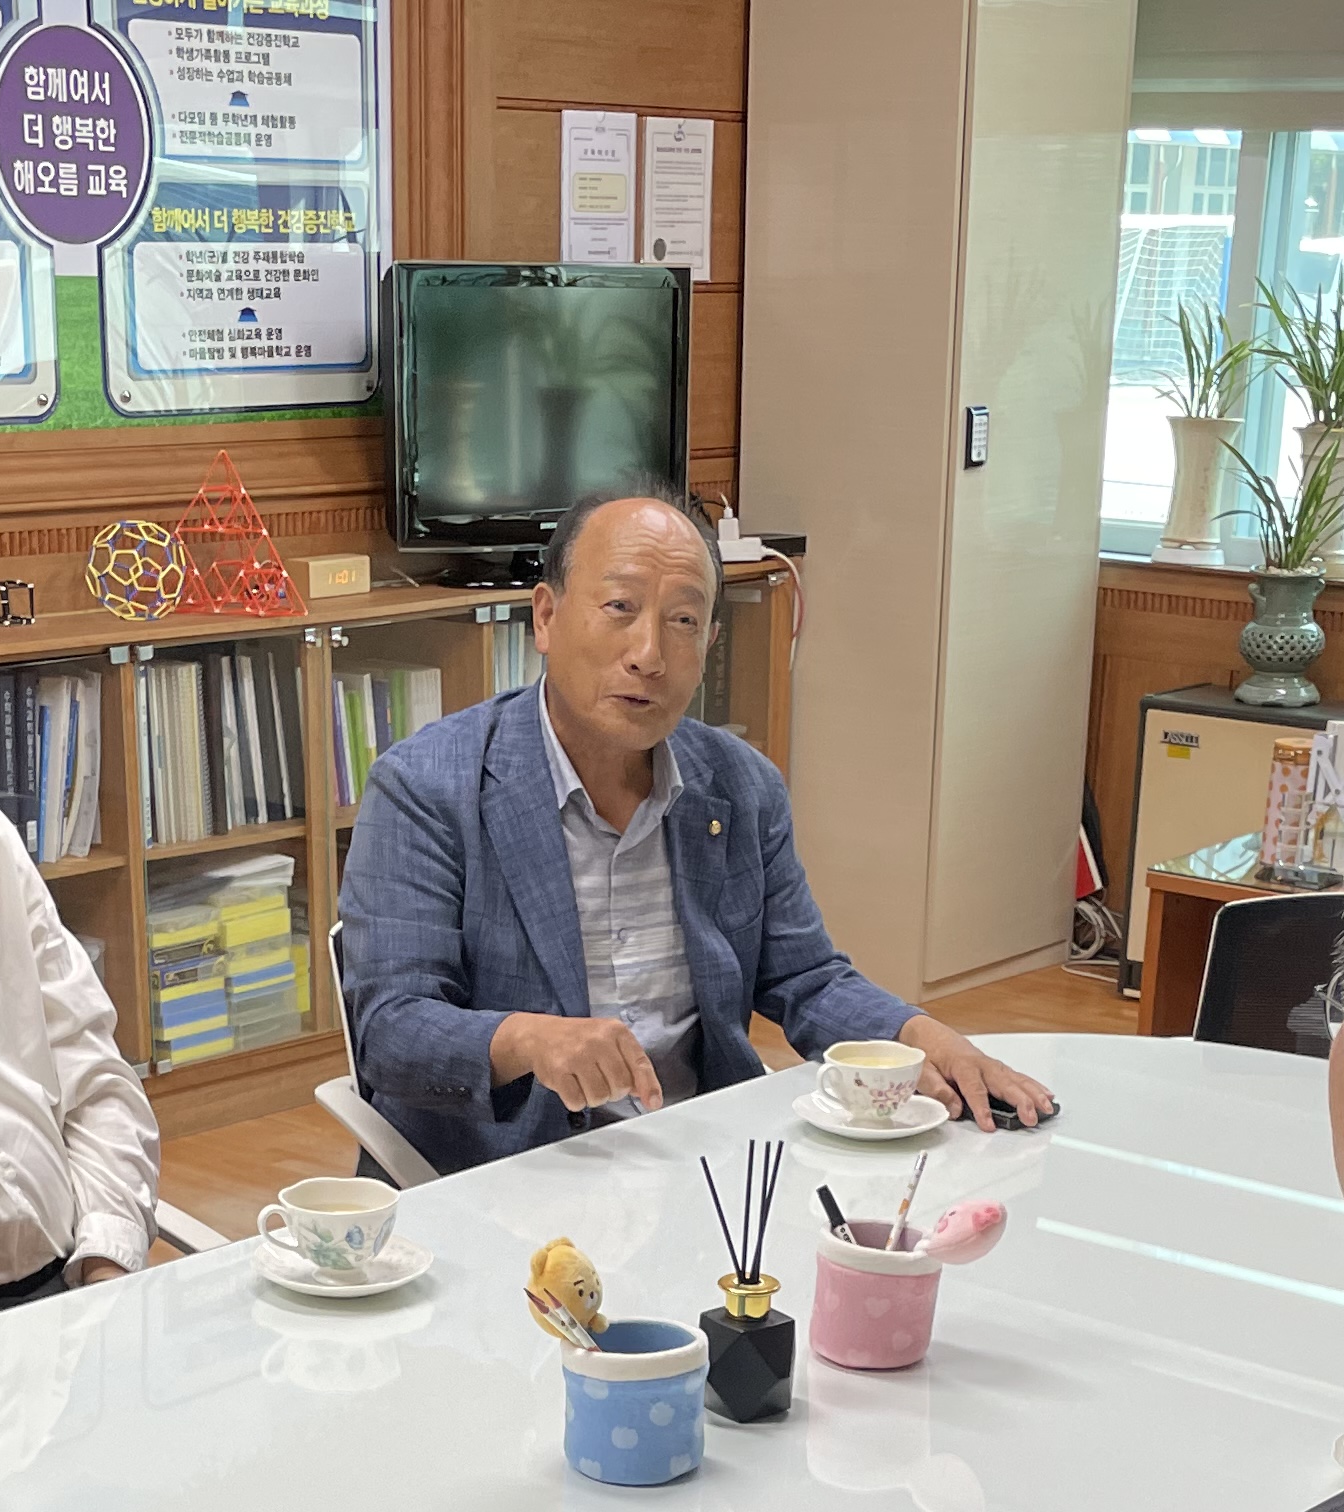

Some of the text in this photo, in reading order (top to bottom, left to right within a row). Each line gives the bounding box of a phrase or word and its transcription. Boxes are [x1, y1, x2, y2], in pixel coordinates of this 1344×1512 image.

[174, 27, 301, 49] 모두가 함께하는 건강증진학교
[234, 50, 271, 66] 프로그램
[176, 66, 293, 86] 성장하는 수업과 학습공동체
[23, 65, 110, 106] 함께여서
[178, 111, 206, 126] 다모임
[261, 114, 297, 130] 체험활동
[23, 113, 117, 152] 더 행복한
[255, 133, 273, 147] 운영
[13, 160, 128, 198] 해오름 교육
[151, 207, 356, 235] 함께여서 더 행복한 건강증진학교
[232, 250, 250, 264] 건강
[225, 269, 262, 283] 교육으로
[264, 269, 291, 283] 건강한
[293, 269, 319, 282] 문화인
[186, 287, 282, 301] 지역과 연계한 생태교육
[265, 327, 283, 341] 운영
[295, 345, 312, 359] 운영
